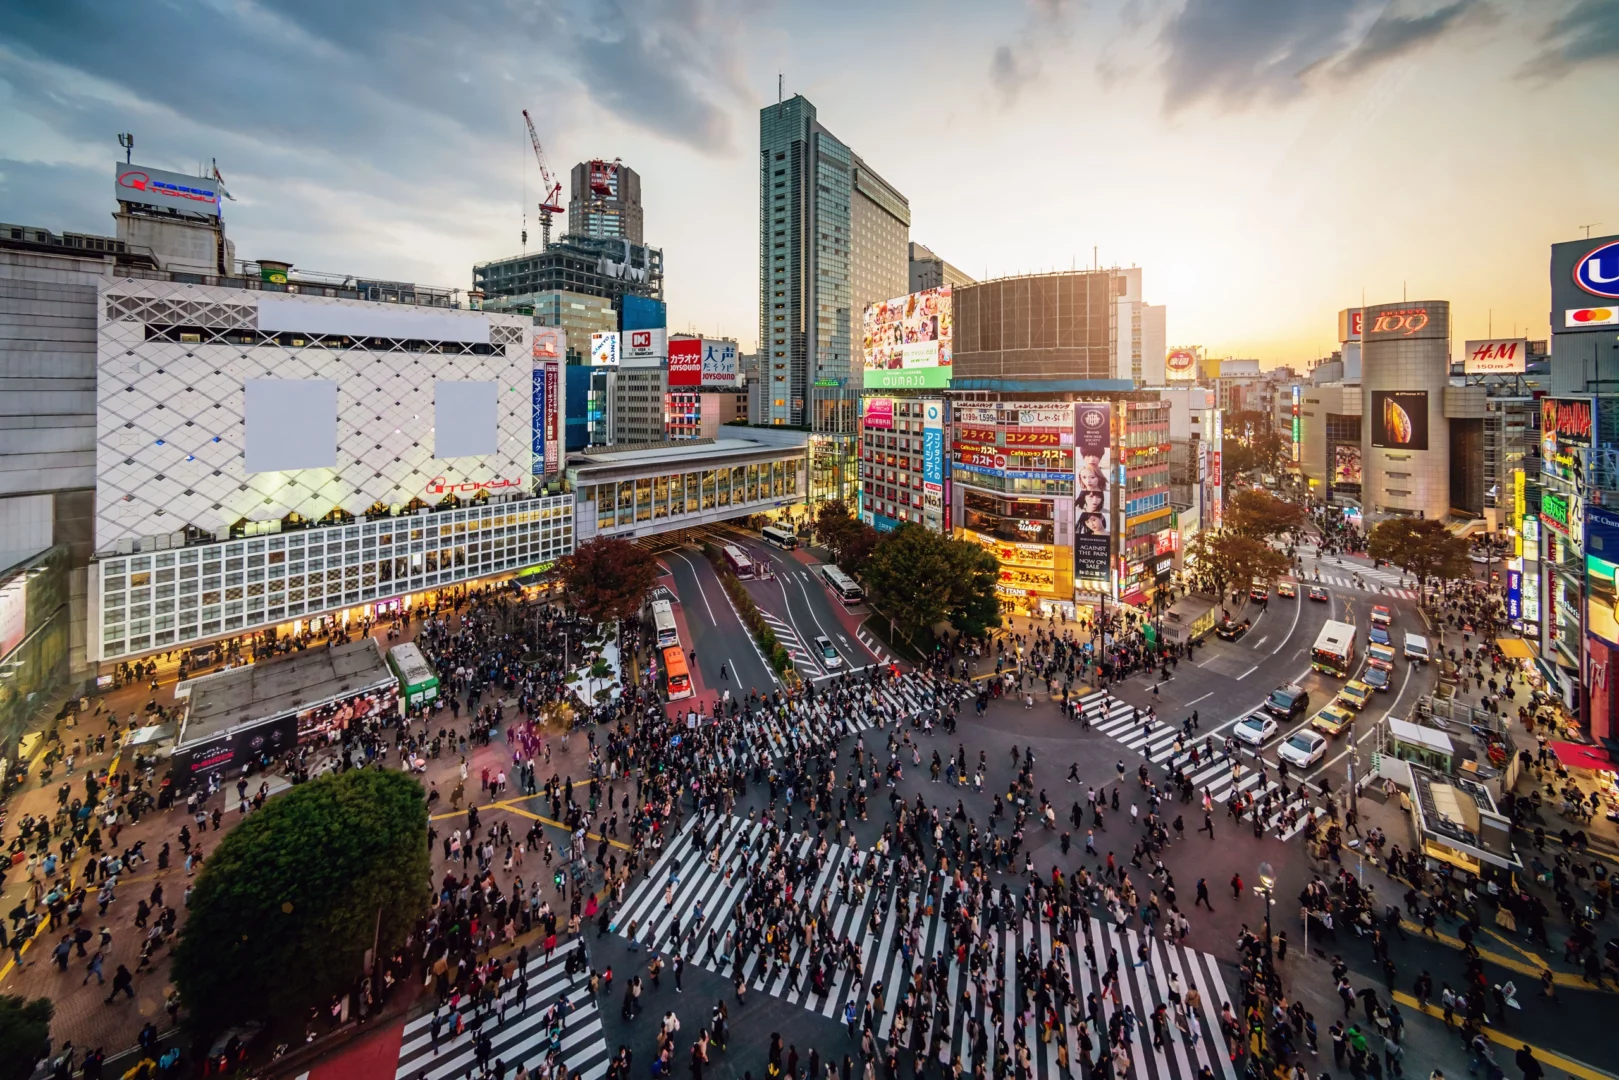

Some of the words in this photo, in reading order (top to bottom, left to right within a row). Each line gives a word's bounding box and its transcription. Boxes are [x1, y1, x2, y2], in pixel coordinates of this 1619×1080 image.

[146, 186, 216, 203] TOKYU
[1370, 313, 1428, 336] 109
[633, 333, 649, 346] DC
[703, 345, 735, 363] 大声
[1472, 342, 1518, 361] H&M
[670, 353, 701, 364] カラオケ
[670, 364, 701, 372] JOYSOUND
[1006, 433, 1058, 443] コンタクト
[926, 432, 934, 479] アイシティ
[980, 445, 998, 455] ガスト
[1042, 450, 1067, 459] ガスト
[972, 454, 993, 466] ガスト
[443, 478, 521, 492] TOKYU
[1588, 513, 1601, 523] DHC
[1079, 544, 1107, 552] AGAINST
[1156, 559, 1171, 572] LUSH
